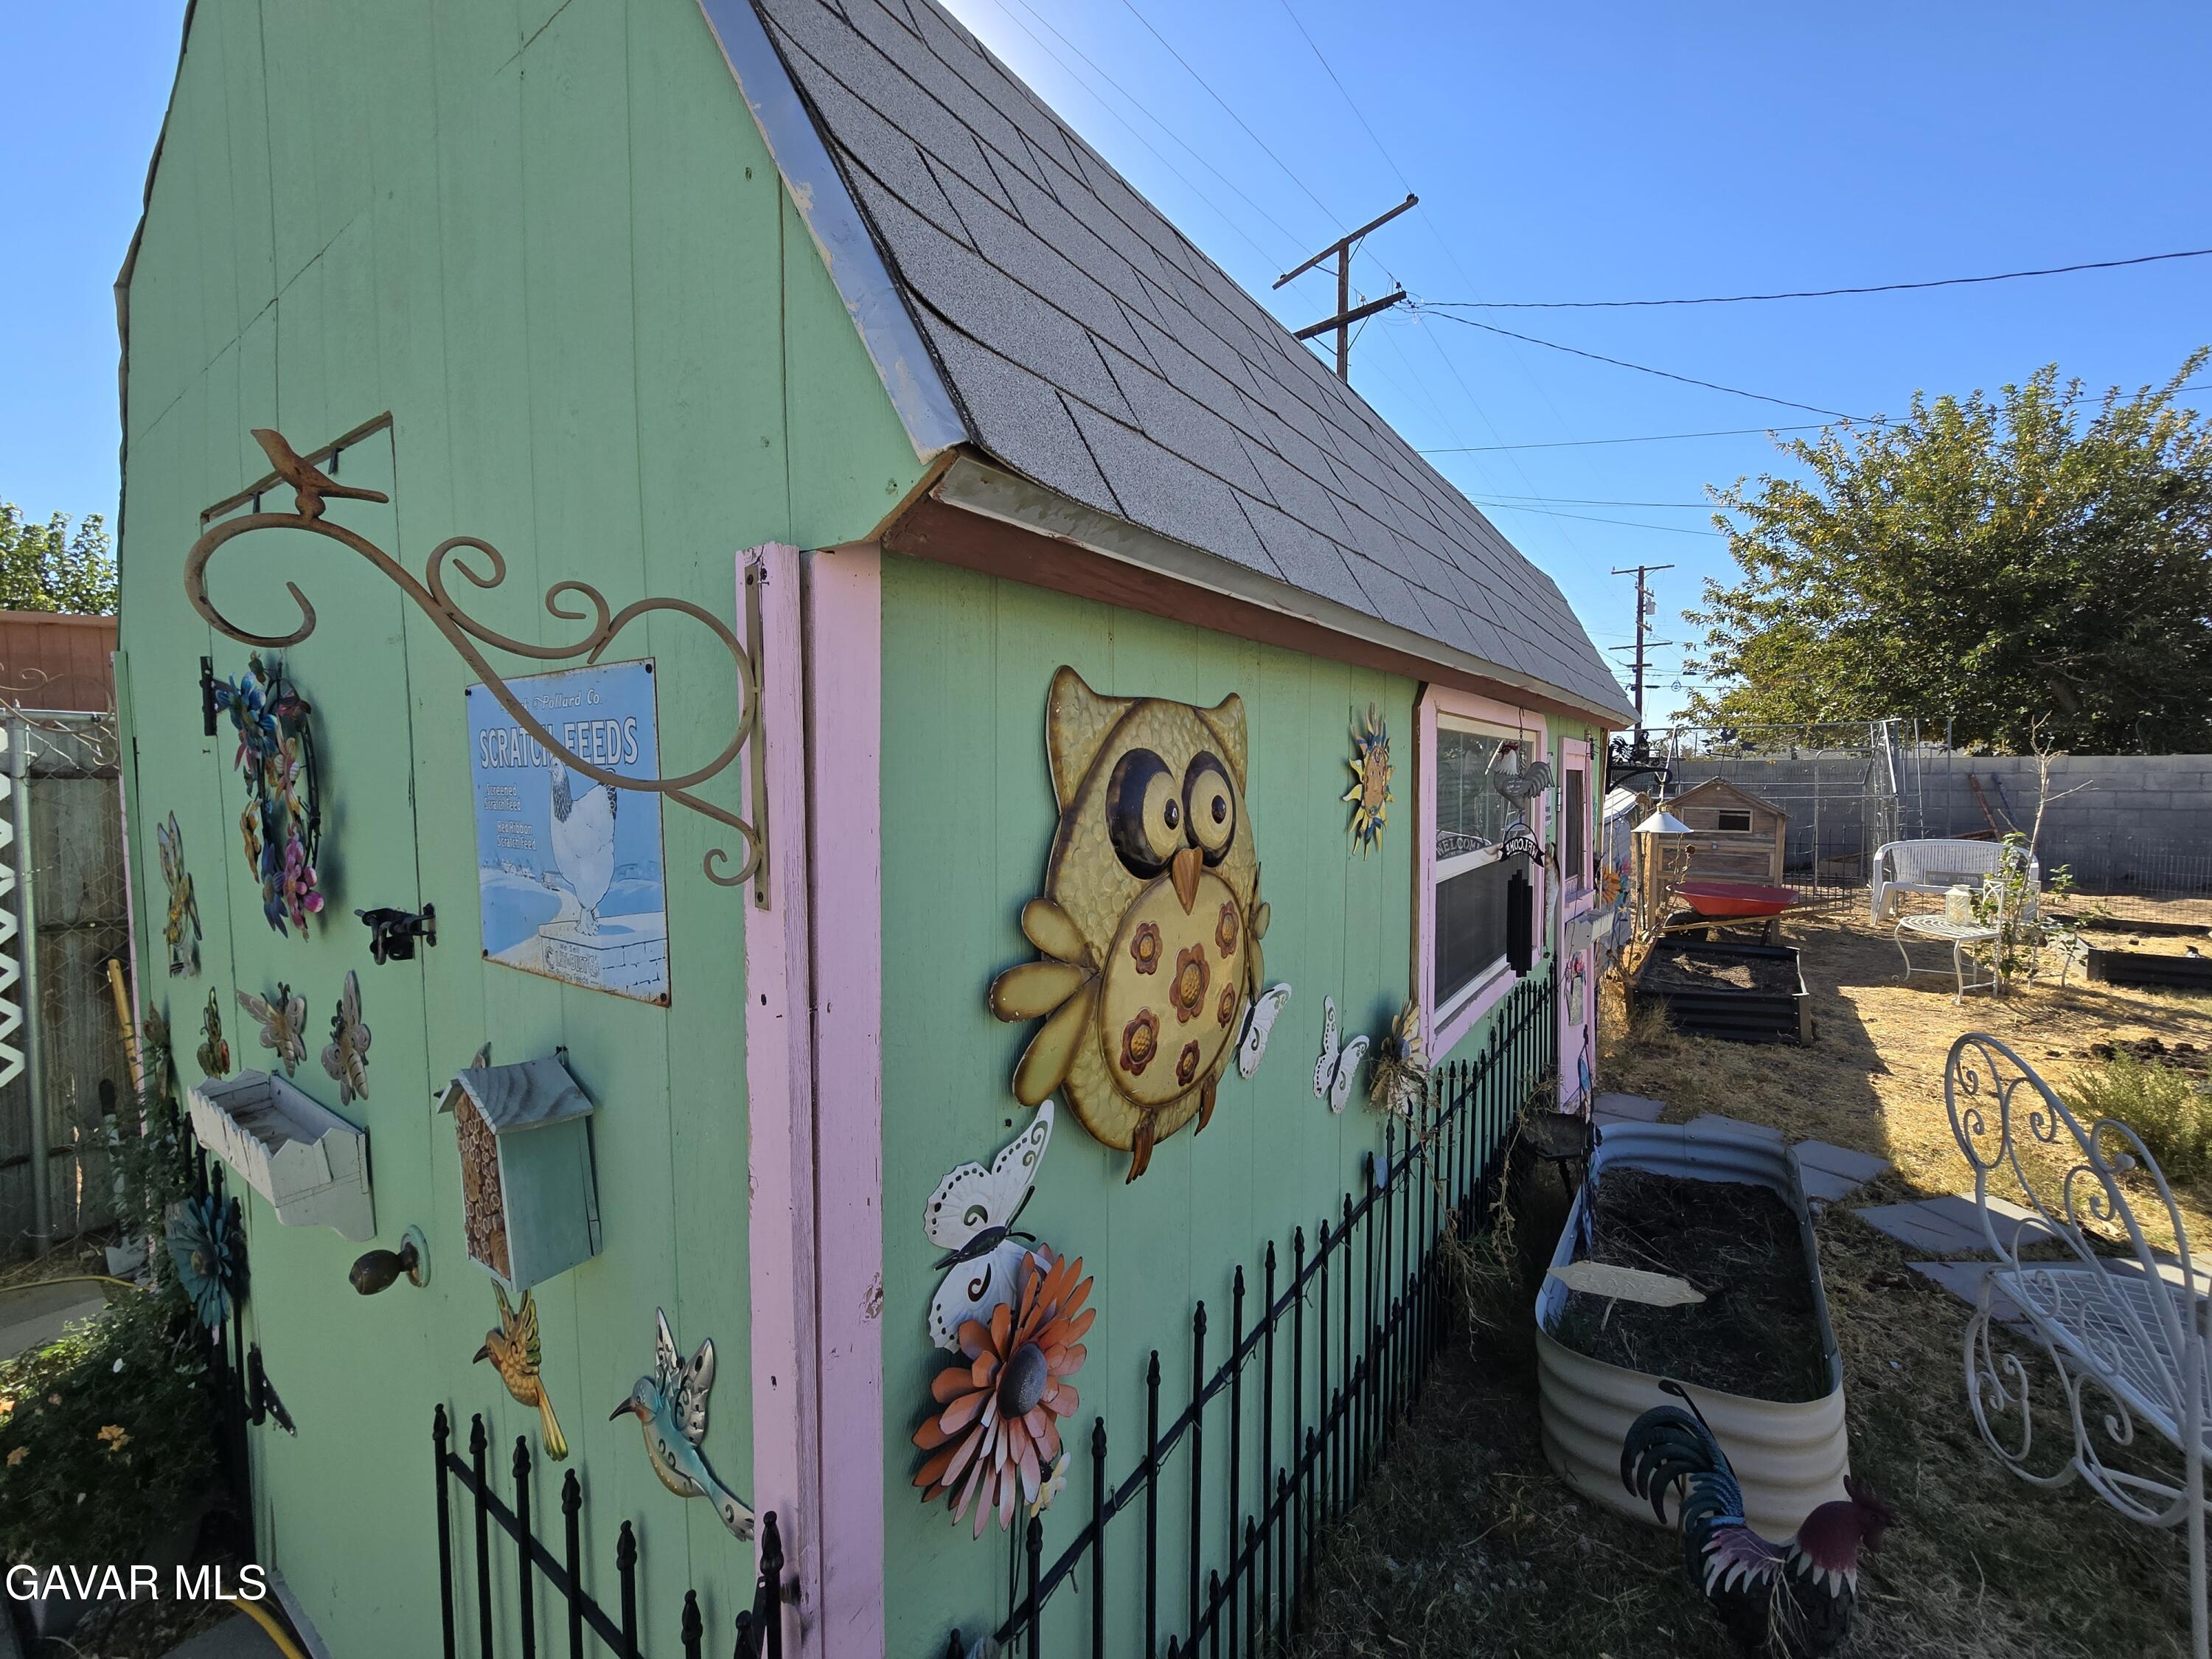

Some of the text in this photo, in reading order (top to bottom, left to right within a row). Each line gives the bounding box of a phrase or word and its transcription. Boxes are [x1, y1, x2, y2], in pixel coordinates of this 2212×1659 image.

[535, 690, 582, 710] Pollard
[587, 689, 602, 706] Co.
[479, 716, 639, 768] SCRATCH FEEDS
[487, 783, 518, 796] Screened
[484, 797, 521, 812] Scratch Feed
[497, 820, 533, 835] Red Ribbon
[497, 834, 537, 851] Scratch Feed
